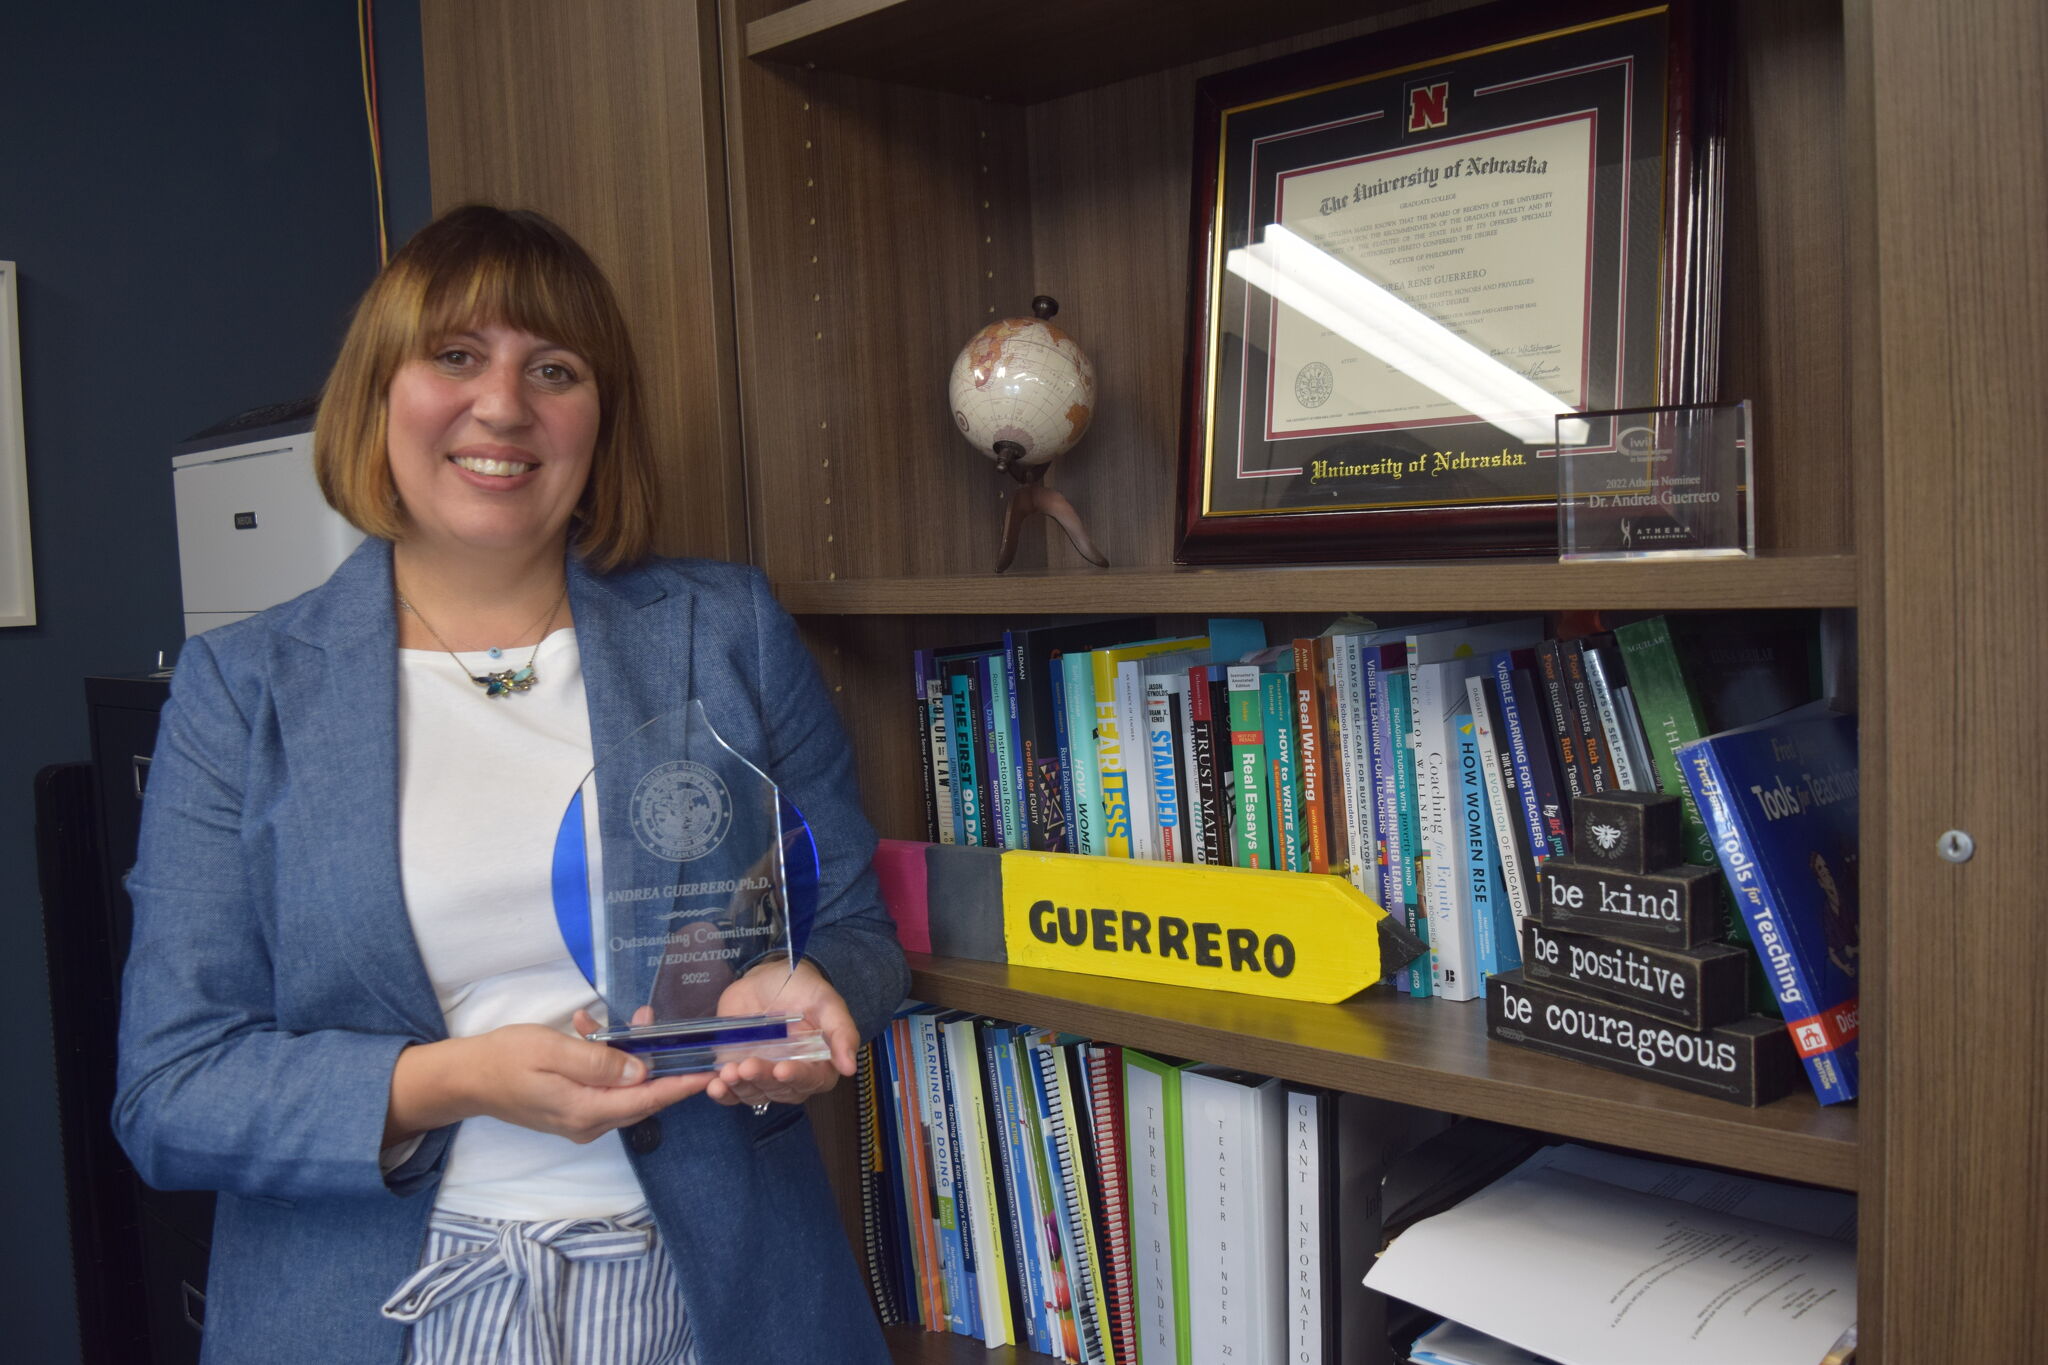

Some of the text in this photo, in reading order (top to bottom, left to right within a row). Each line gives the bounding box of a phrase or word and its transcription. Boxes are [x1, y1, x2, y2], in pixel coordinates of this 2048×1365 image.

[1408, 81, 1449, 132] N
[1320, 156, 1548, 216] The University of Nebraska
[1434, 269, 1487, 285] GUERRERO
[1310, 458, 1402, 484] University
[1408, 454, 1427, 472] of
[1606, 476, 1701, 489] 2022 Athena Nominee
[1589, 491, 1720, 508] Dr. Andrea Guerrero
[1335, 646, 1343, 679] Building
[1542, 654, 1557, 680] Poor
[1337, 680, 1345, 702] Great
[1549, 682, 1567, 735] Students,
[1568, 654, 1600, 765] Poor Students, Rich
[932, 697, 947, 743] COLOR
[986, 709, 994, 729] Data
[1017, 646, 1038, 825] FELDMAN Grading for EQUITY
[1340, 703, 1348, 731] School
[1393, 707, 1402, 748] ENGAGING
[1593, 680, 1630, 786] DAYS OF SELF-CARE
[954, 691, 975, 811] THE FIRST 90
[997, 731, 1011, 795] Instructional
[1196, 723, 1213, 792] TRUST
[1298, 689, 1317, 801] Real Writing
[1348, 644, 1371, 870] 180 DAYS OF SELF-CARE FOR BUSY EDUCATORS
[1461, 742, 1478, 787] HOW
[1495, 661, 1543, 848] VISIBLE LEARNING FOR TEACHERS
[1561, 737, 1574, 763] Rich
[937, 760, 950, 787] LAW
[1015, 766, 1024, 790] Leading
[1059, 747, 1073, 821] Rural Education in
[1074, 758, 1087, 798] HOW
[1095, 701, 1127, 839] FEARLESS
[1151, 730, 1178, 828] STAMPED
[1242, 753, 1255, 789] Real
[1278, 728, 1293, 831] HOW to WRITE
[1342, 733, 1355, 829] Board-Superintendent
[1366, 659, 1392, 900] VISIBLE LEARNING FOR TEACHERS JOHN
[1396, 749, 1405, 789] STUDENTS
[1500, 752, 1515, 789] Talk to Me
[992, 780, 1001, 812] BOUDETT
[1003, 798, 1014, 836] Rounds
[1399, 792, 1407, 812] WITH
[1409, 662, 1437, 943] EDUCATOR WELLNESS KANOLD BOOGREN
[1472, 687, 1523, 918] DAGGETT THE EVOLUTION OF EDUCATION
[1751, 776, 1798, 822] Tools
[1244, 793, 1259, 850] Essays
[1312, 825, 1320, 861] READINGS
[1385, 775, 1403, 903] THE UNFINISHED LEADER
[1429, 751, 1453, 922] Coaching for Equity
[1466, 792, 1483, 862] WOMEN
[1404, 856, 1412, 864] IN
[606, 889, 660, 903] ANDREA
[739, 877, 772, 891] Ph.D.
[1472, 868, 1487, 903] RISE
[1548, 876, 1681, 921] be kind
[1719, 824, 1802, 1004] Tools for Teaching
[609, 924, 774, 952] Outstanding Commitment
[647, 948, 741, 967] IN EDUCATION
[1028, 900, 1296, 978] GUERRERO
[682, 972, 710, 985] 2022
[1532, 928, 1558, 964] be
[1569, 944, 1686, 1000] positive
[1501, 985, 1737, 1072] be courageous
[924, 1023, 950, 1188] LEARNING BY DOING
[948, 1103, 957, 1138] Teaching
[1006, 1086, 1019, 1145] ENGLISH ACTION
[953, 1140, 961, 1163] Gifted
[1298, 1104, 1309, 1183] GRANT
[958, 1191, 967, 1219] Today's
[988, 1062, 1000, 1103] HANDBOOK
[997, 1121, 1008, 1163] ENHANCING
[1003, 1164, 1016, 1221] PROFESSIONAL
[1012, 1220, 1022, 1256] PRACTICE
[1018, 1262, 1029, 1303] DANIELSON
[961, 1221, 970, 1260] Classroom
[1147, 1106, 1166, 1347] THREAT BINDER
[1217, 1120, 1233, 1357] TEACHER BINDER 22
